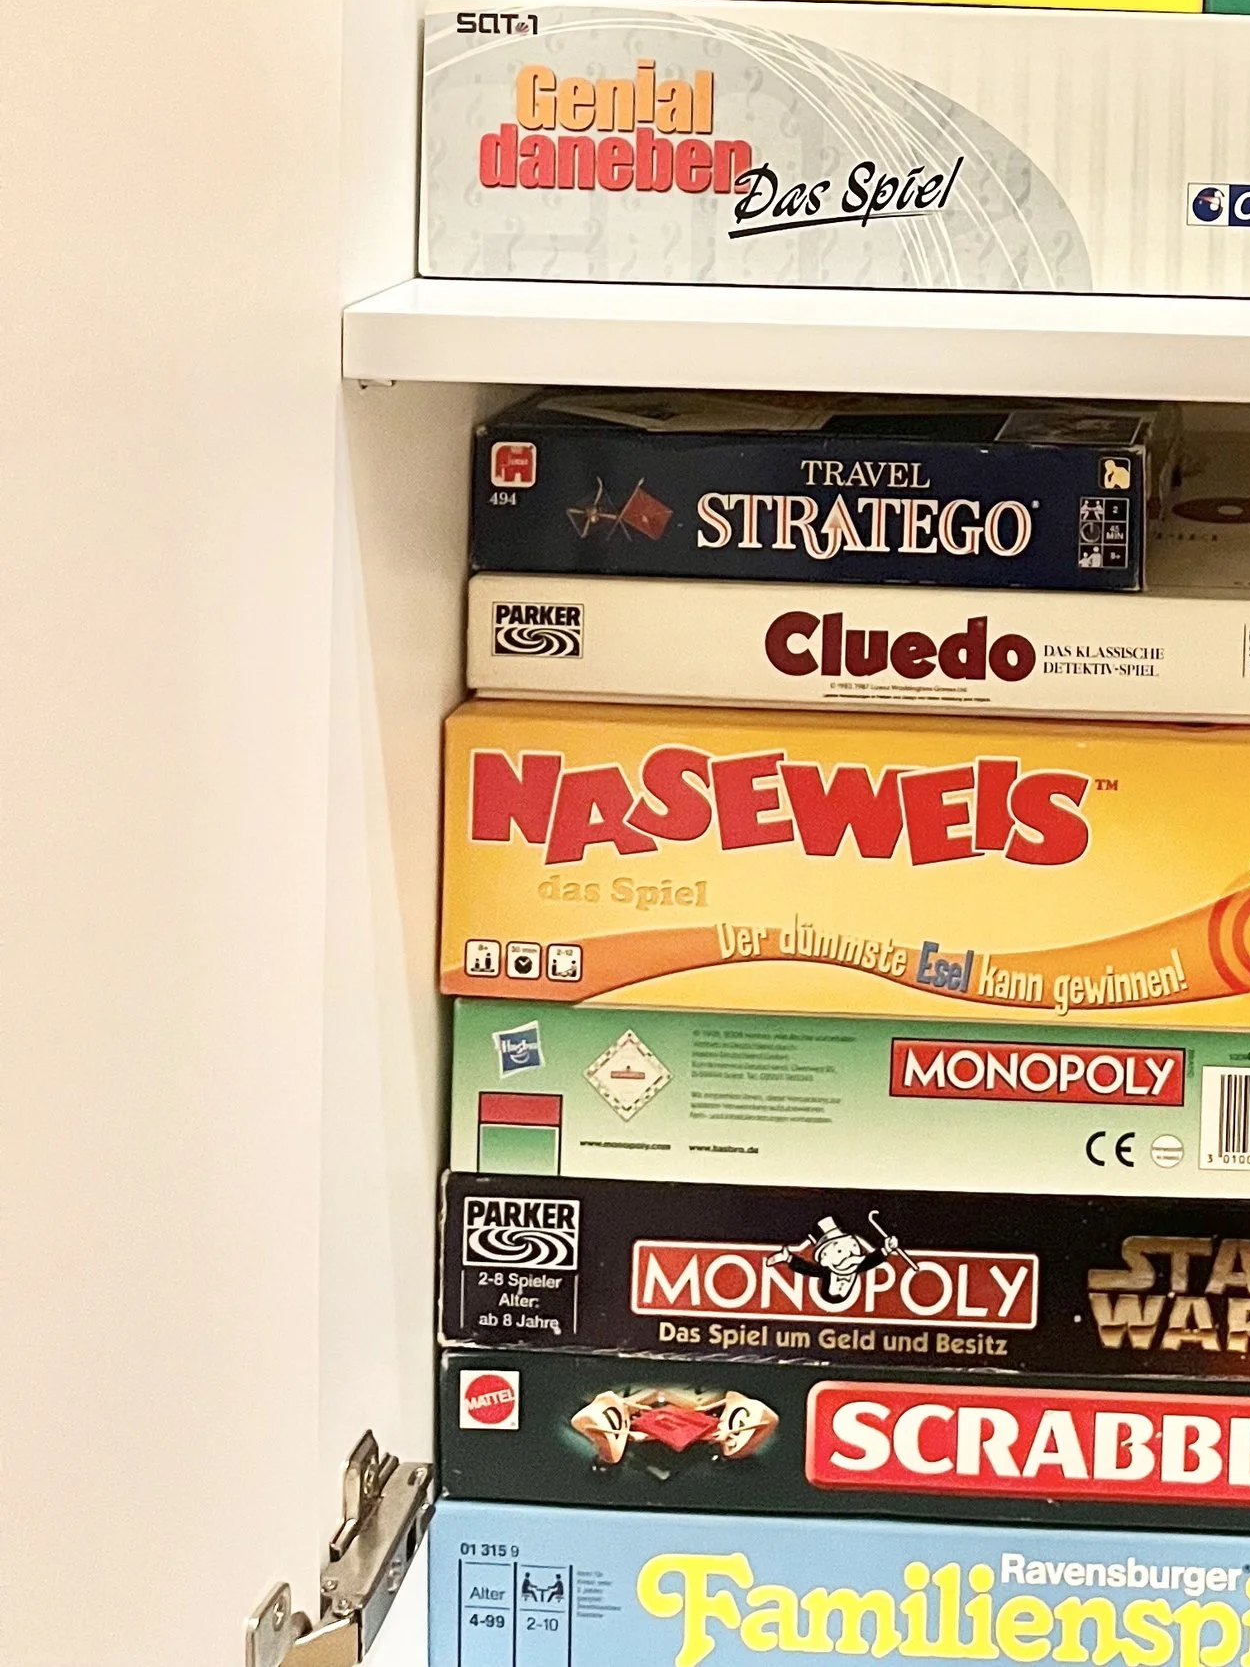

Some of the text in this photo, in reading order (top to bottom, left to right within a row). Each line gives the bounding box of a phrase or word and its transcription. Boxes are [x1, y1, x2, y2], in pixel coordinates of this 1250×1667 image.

[515, 59, 715, 135] Genial
[479, 123, 754, 194] daneben
[733, 155, 965, 228] Das Spiel
[800, 460, 931, 489] TRAVEL
[489, 491, 517, 505] 494
[697, 491, 1033, 560] STRATEGO
[1106, 531, 1124, 540] MIN
[496, 604, 581, 626] PARKER
[764, 610, 1036, 682] Cluedo
[1044, 644, 1165, 660] DAS KLASSISCHE
[1043, 661, 1160, 677] DETEKTIV-SPIEL
[470, 744, 1092, 866] NASEWEIS
[538, 876, 709, 910] das Spiel
[716, 913, 1190, 1017] Der dümmste Esel kann gewinnen!
[903, 1048, 1176, 1097] MONOPOLY
[579, 1140, 671, 1151] www.monopoly.com
[689, 1143, 760, 1154] www.hasbro.de
[1207, 1153, 1213, 1163] 3
[466, 1200, 576, 1230] PARKER
[478, 1273, 562, 1292] 2-8 Spieler
[642, 1252, 1029, 1318] MONOPOLY
[499, 1292, 539, 1309] Alter:
[478, 1312, 497, 1328] ab
[499, 1313, 512, 1327] 8
[659, 1322, 1009, 1357] Das Spiel um Geld und Besitz
[465, 1388, 516, 1411] MATTEL
[460, 1542, 520, 1558] 01 315 9
[1001, 1553, 1242, 1591] Ravensburger
[469, 1586, 506, 1601] Alter
[469, 1613, 505, 1628] 4-99
[526, 1617, 559, 1632] 2-10
